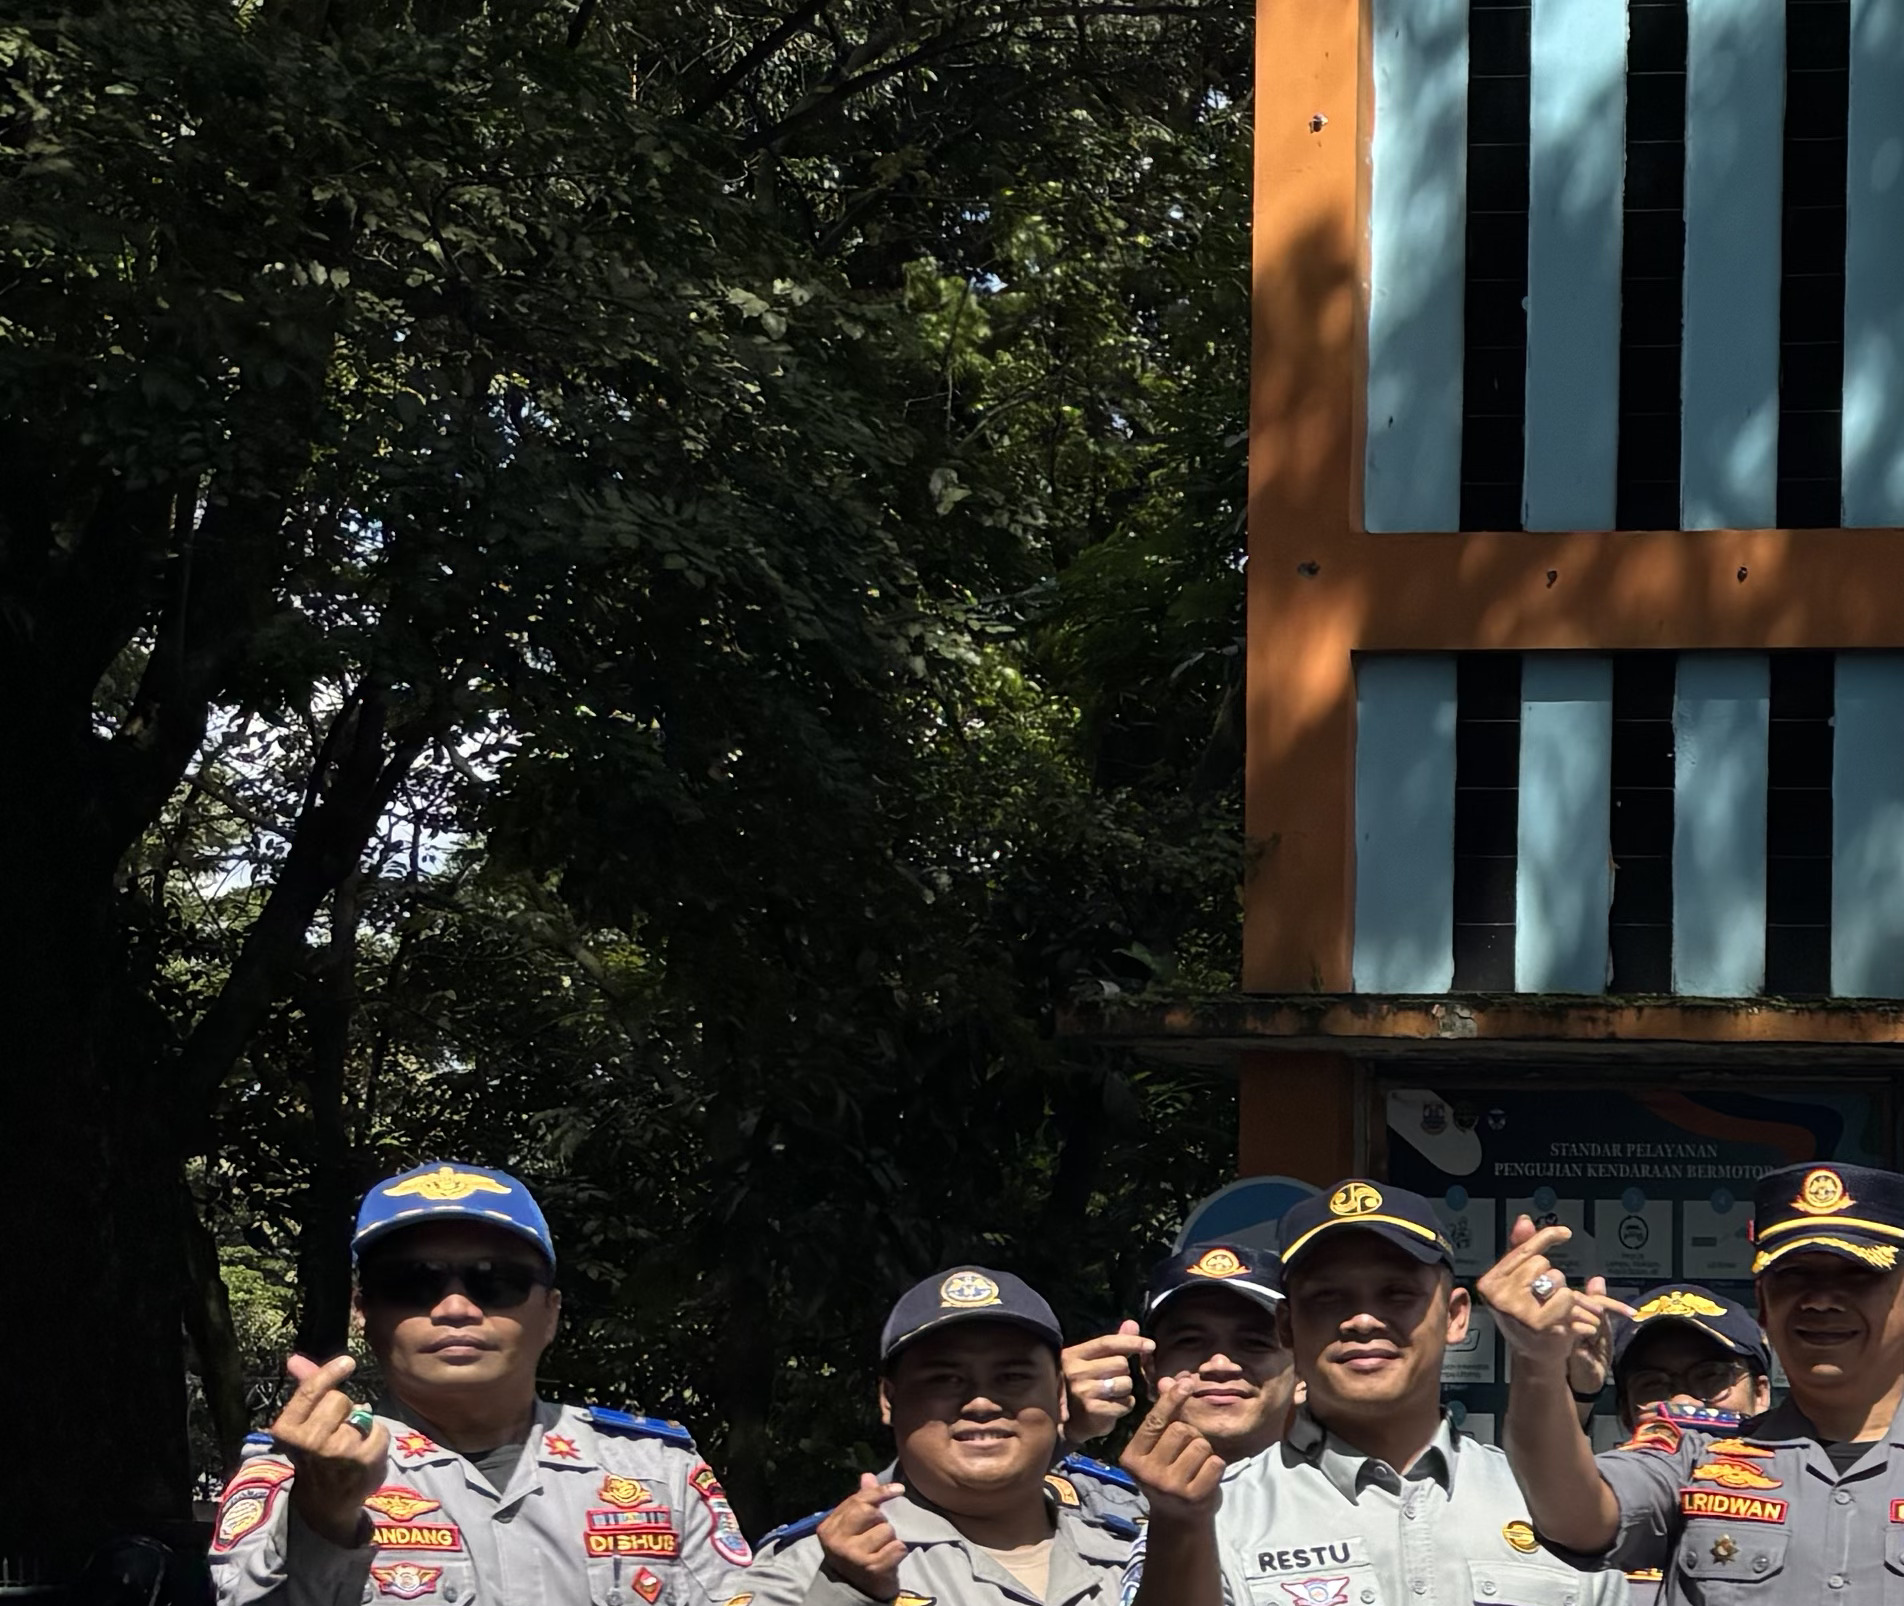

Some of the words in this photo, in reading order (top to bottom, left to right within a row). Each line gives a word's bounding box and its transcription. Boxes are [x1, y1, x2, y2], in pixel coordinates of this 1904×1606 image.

[1550, 1142, 1623, 1158] STANDAR
[1626, 1143, 1718, 1159] PELAYANAN
[1494, 1161, 1583, 1178] PENGUJIAN
[1587, 1162, 1683, 1179] KENDARAAN
[371, 1527, 455, 1547] ANDANG
[589, 1533, 676, 1552] DISHUB
[1257, 1540, 1352, 1572] RESTU
